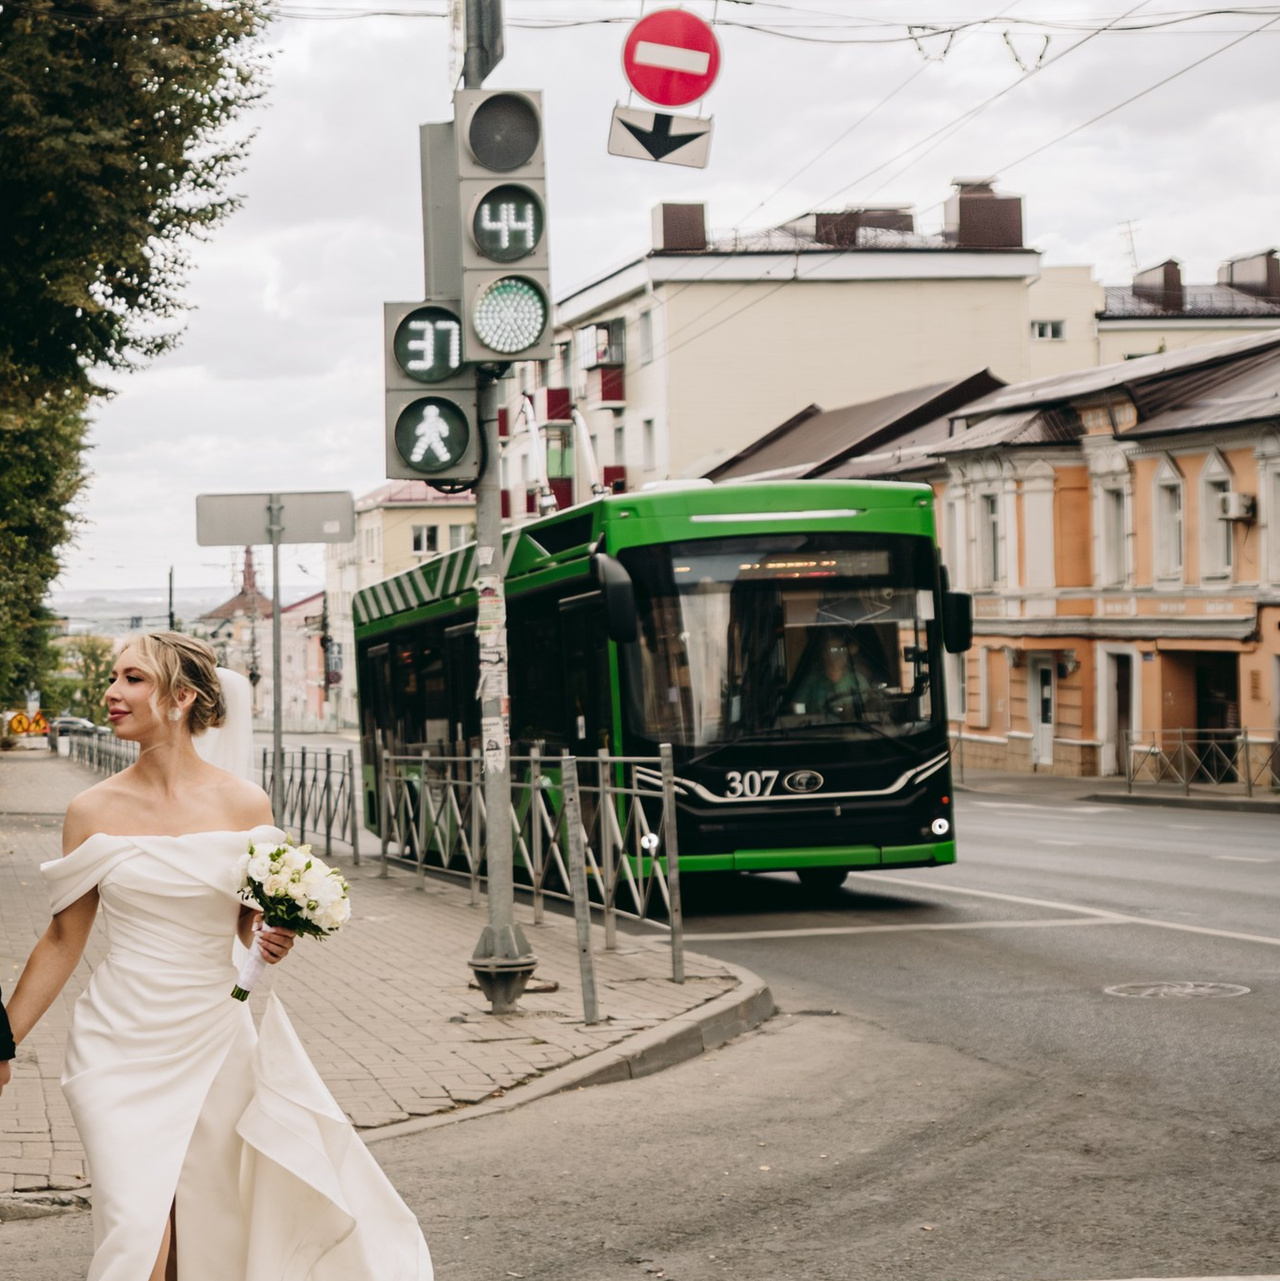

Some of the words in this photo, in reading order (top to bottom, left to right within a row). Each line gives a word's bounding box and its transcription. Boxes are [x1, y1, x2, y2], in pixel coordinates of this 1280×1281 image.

[481, 203, 534, 249] 44
[407, 320, 460, 370] 37
[725, 770, 779, 798] 307
